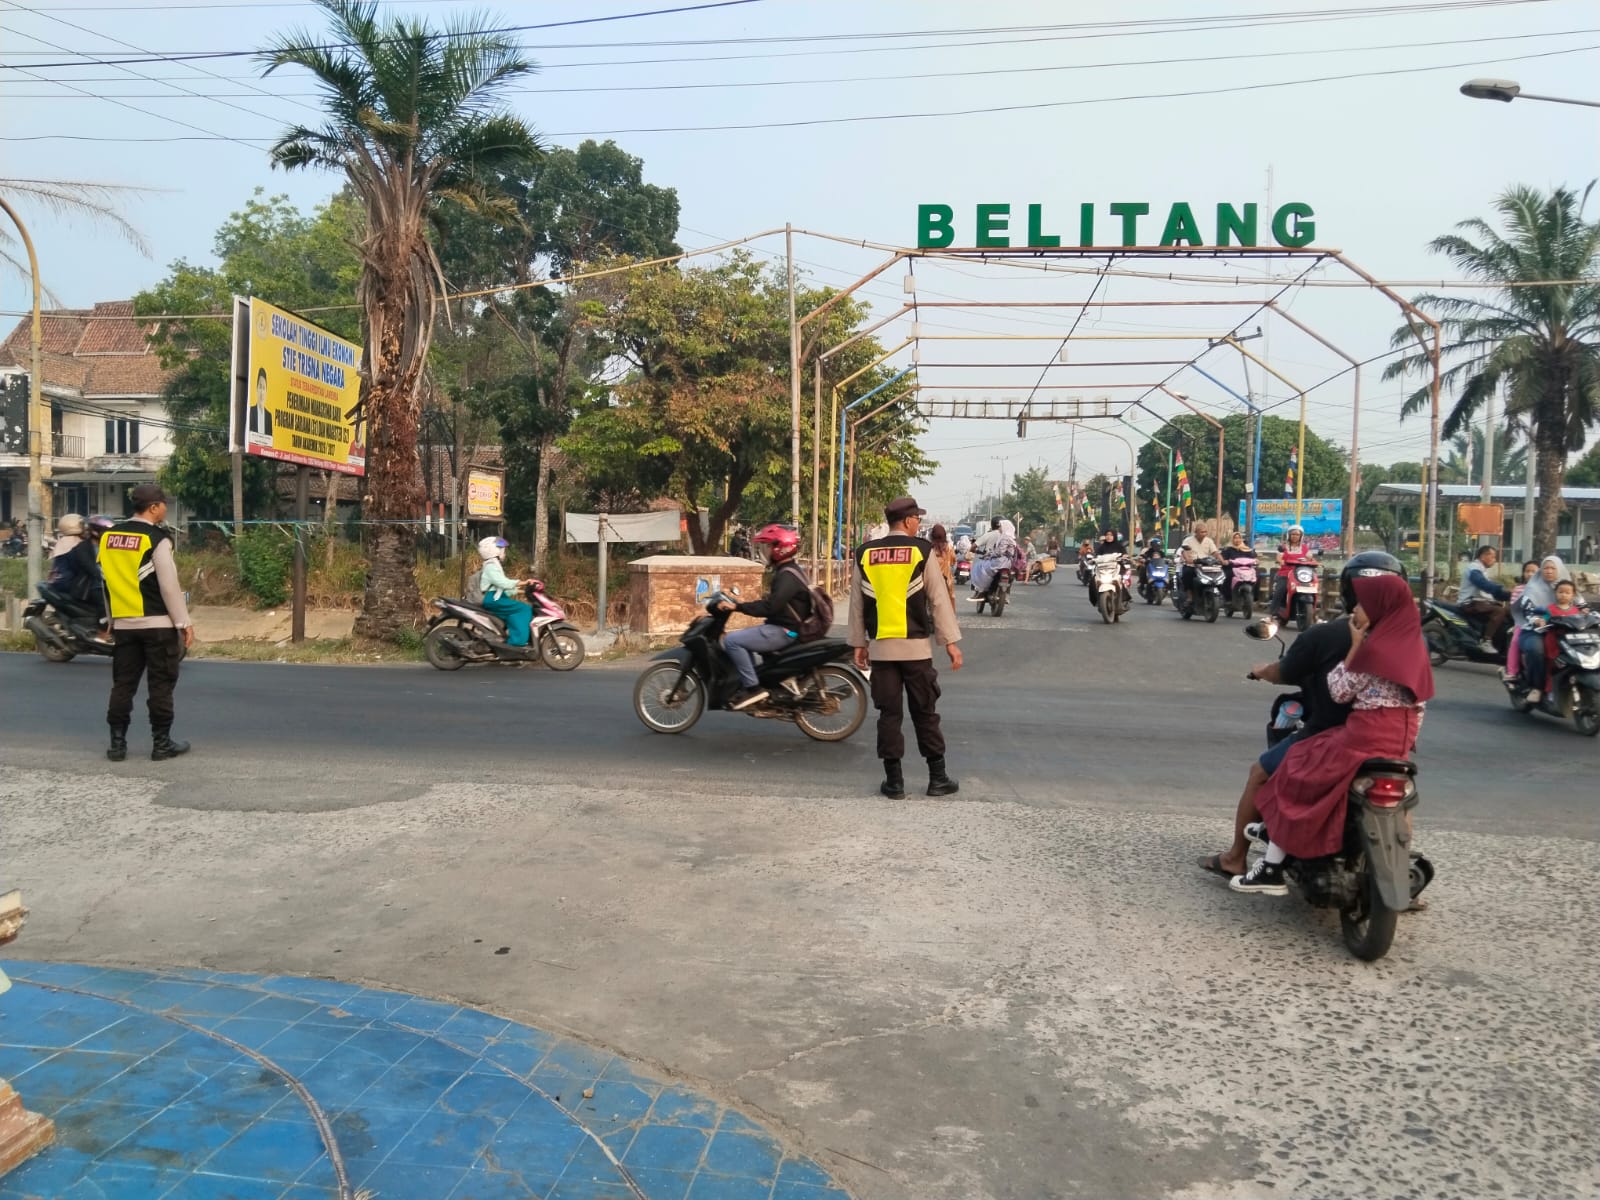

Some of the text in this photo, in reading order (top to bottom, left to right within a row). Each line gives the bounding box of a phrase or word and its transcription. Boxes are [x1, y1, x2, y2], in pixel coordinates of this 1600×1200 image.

[917, 202, 1316, 248] BELITANG
[272, 313, 298, 344] SEKOLAH
[299, 325, 318, 353] TINGGI
[282, 345, 297, 372] STIE
[321, 361, 345, 389] NEGARA
[107, 535, 140, 549] POLISI
[870, 549, 910, 564] POLISI
